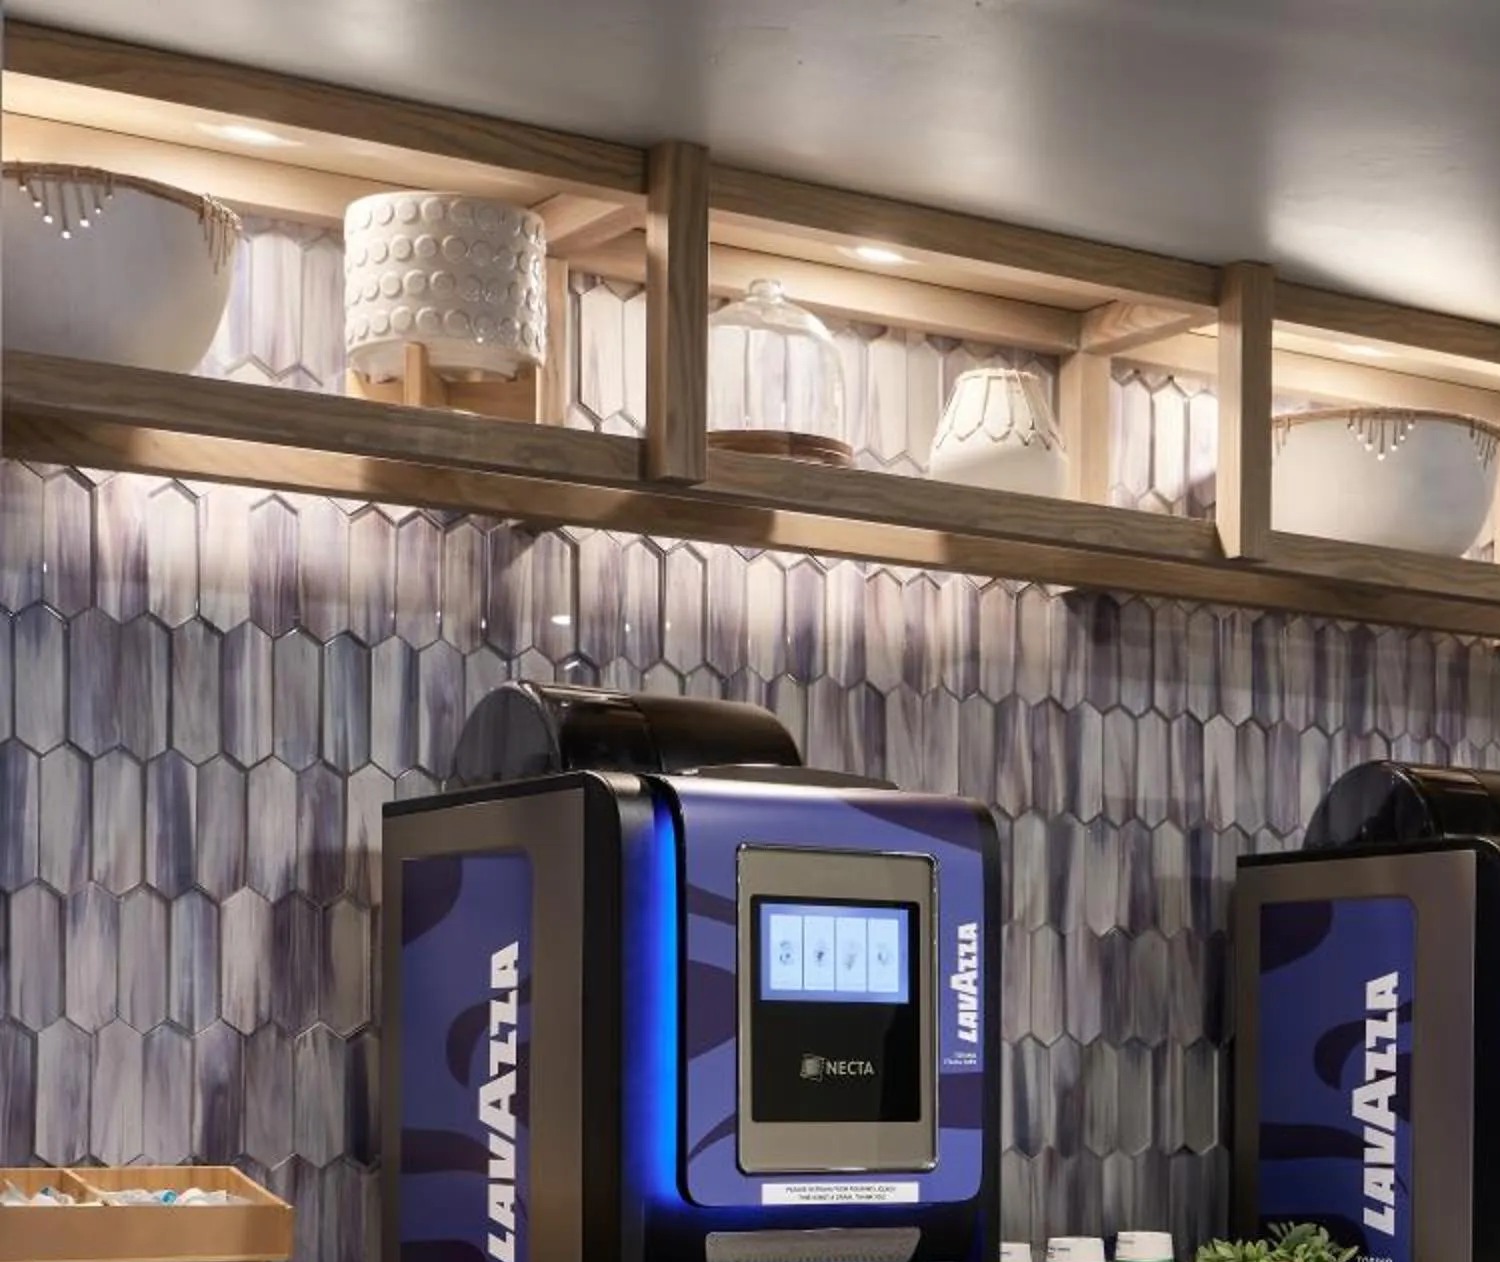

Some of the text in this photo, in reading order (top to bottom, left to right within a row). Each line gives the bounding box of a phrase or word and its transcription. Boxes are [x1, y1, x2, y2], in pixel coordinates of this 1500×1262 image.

[950, 922, 978, 1043] LAVAZZA
[825, 1061, 875, 1076] NECTA
[1352, 971, 1399, 1236] LAVAZZA
